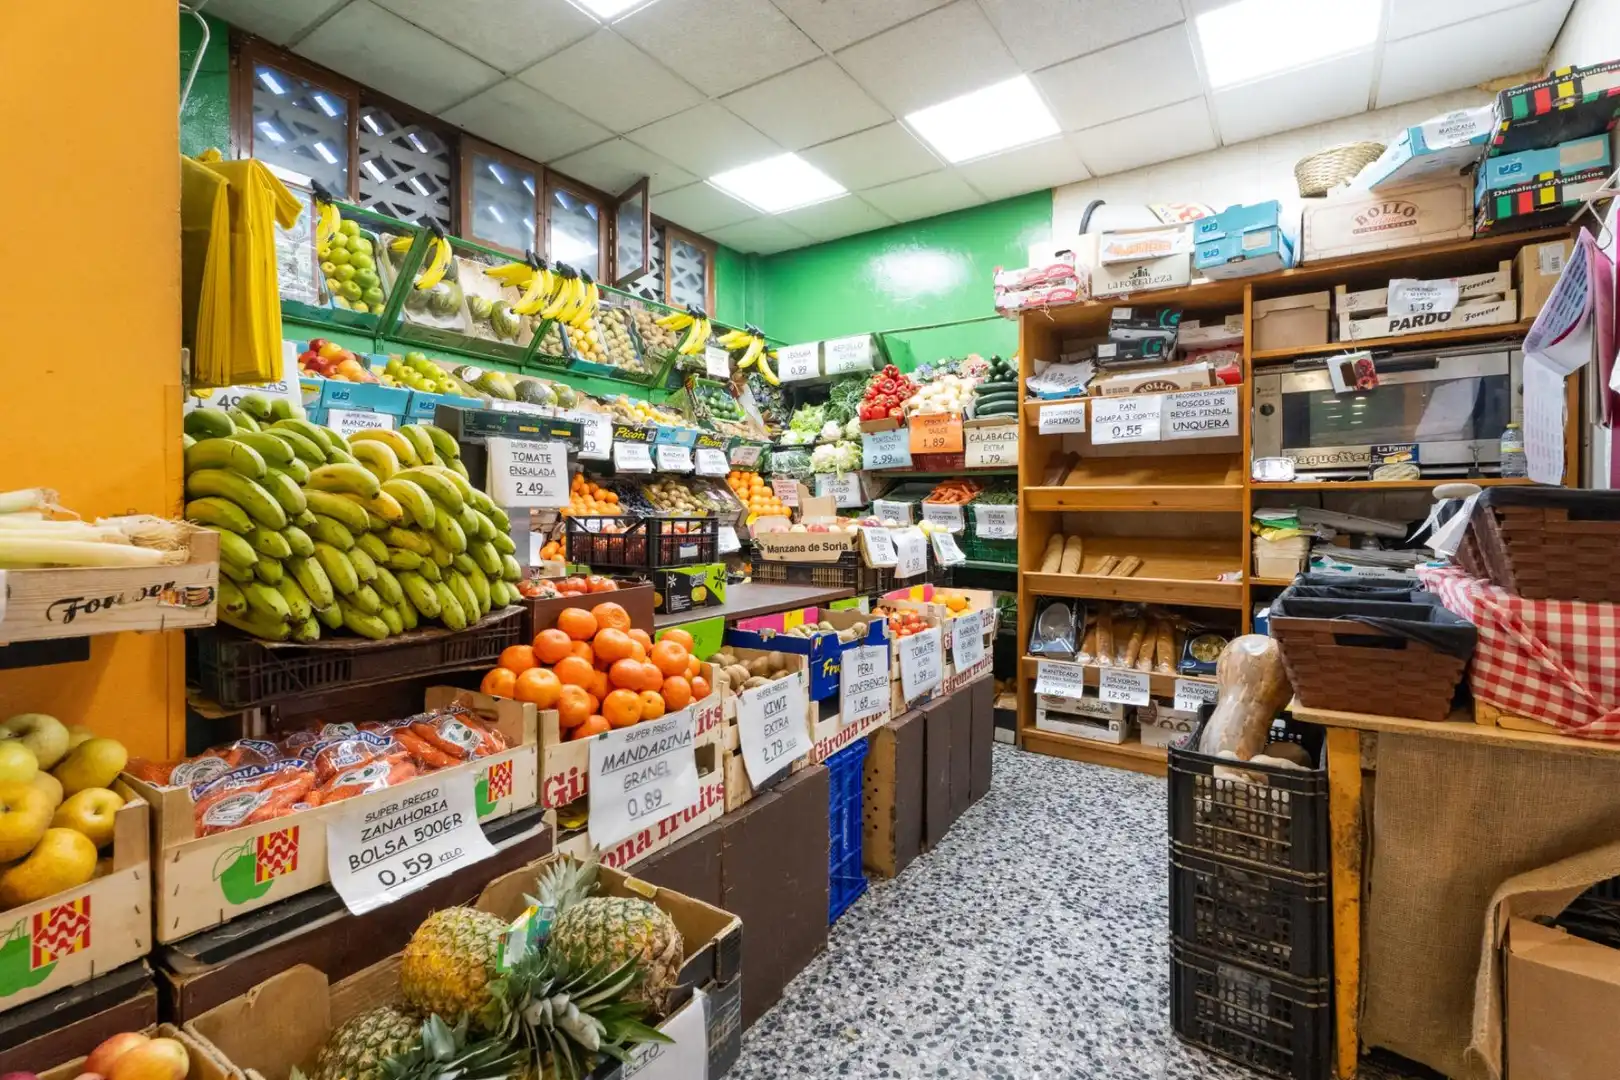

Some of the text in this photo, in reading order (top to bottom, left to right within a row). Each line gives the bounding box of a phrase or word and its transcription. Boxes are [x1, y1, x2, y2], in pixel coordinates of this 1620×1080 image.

[1507, 79, 1560, 97] Domaines
[1493, 171, 1604, 197] Domaines d'Aquitaine
[1459, 276, 1496, 293] Forever
[1463, 306, 1501, 322] Forever
[1388, 312, 1452, 332] PARDO
[1176, 397, 1225, 408] ROSCOS DE
[1043, 417, 1081, 425] ABRIMOS
[1095, 414, 1122, 423] CHAPA
[1124, 413, 1130, 421] 3
[1170, 410, 1197, 418] REYES
[341, 419, 382, 428] MANZANA
[1112, 424, 1142, 438] 0,55
[1173, 419, 1230, 431] UNQUERA
[923, 437, 945, 448] 1,89
[969, 432, 1018, 442] CALABACIN
[511, 451, 552, 463] TOMATE
[872, 454, 893, 465] 2,99
[980, 454, 1000, 465] 1,79
[509, 465, 557, 477] ENSALADA
[515, 481, 544, 496] 2,49
[767, 542, 849, 554] Manzana de Soria
[857, 662, 874, 674] PERA
[763, 695, 788, 717] KIWI
[625, 720, 678, 742] SUPER PRECIO
[763, 716, 790, 737] EXTRA
[814, 722, 859, 762] Girona
[600, 728, 693, 774] MANDARINA
[761, 739, 784, 762] 2,79
[334, 754, 365, 768] MESA
[623, 761, 672, 790] GRANEL
[364, 788, 440, 823] SUPER PRECIO
[626, 788, 663, 817] 0,89
[360, 799, 449, 842] ZANAHORIA
[348, 812, 463, 870] BOLSA 500GR
[377, 847, 463, 886] 0,59 KILO
